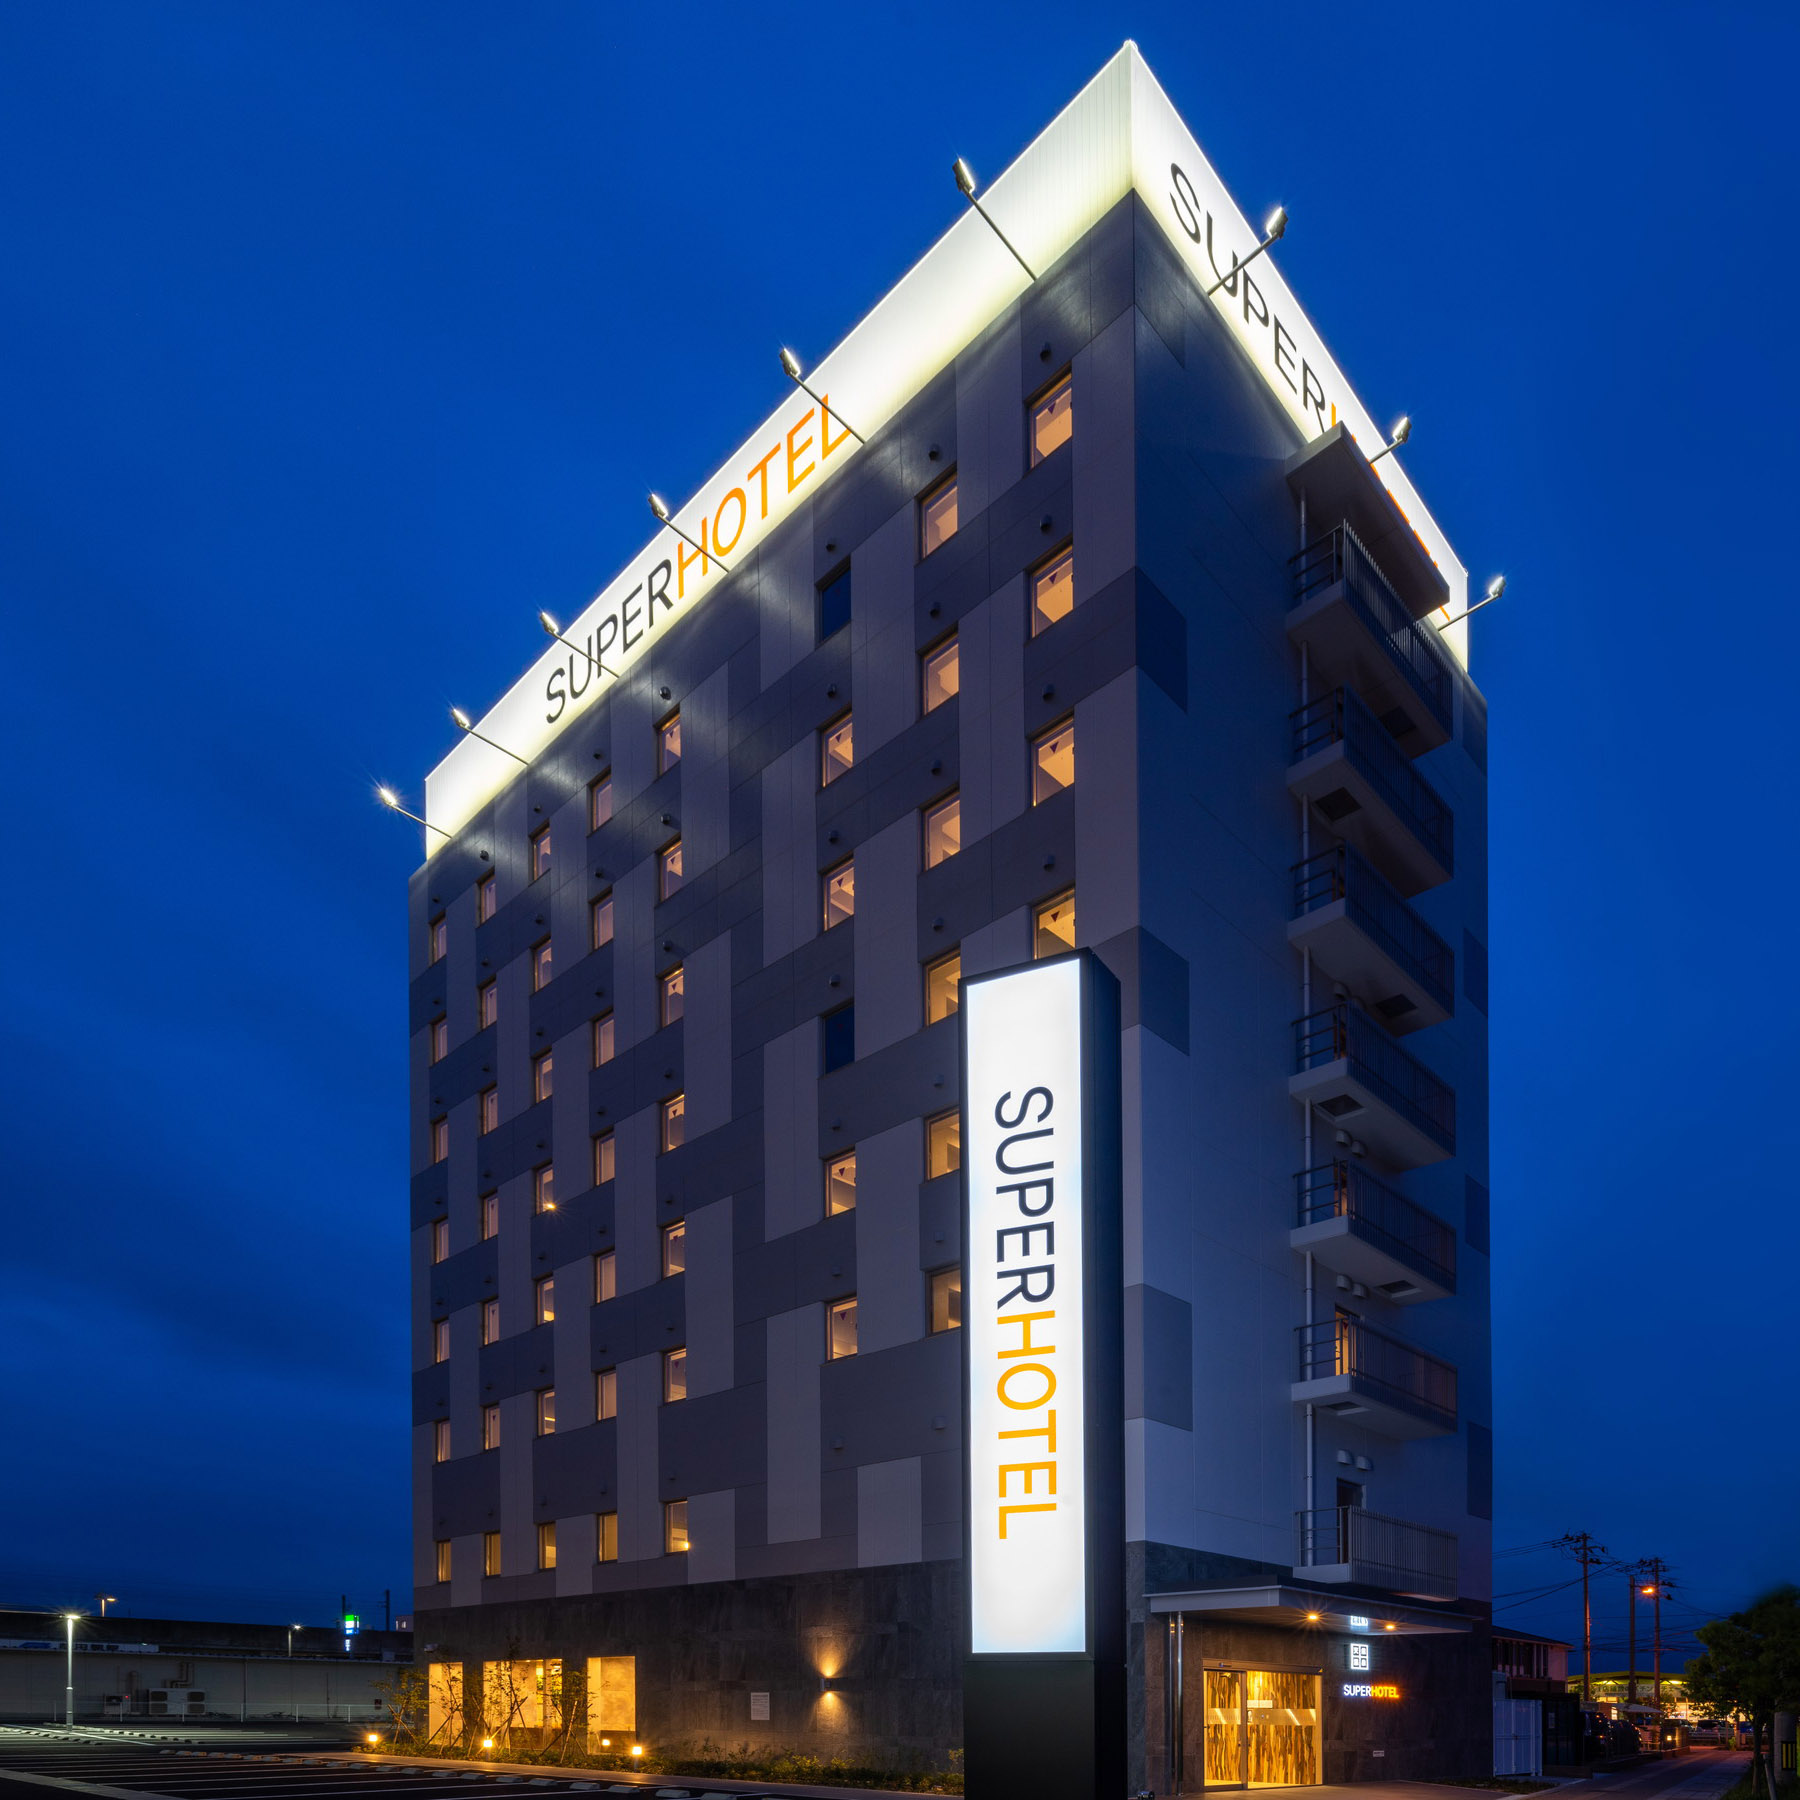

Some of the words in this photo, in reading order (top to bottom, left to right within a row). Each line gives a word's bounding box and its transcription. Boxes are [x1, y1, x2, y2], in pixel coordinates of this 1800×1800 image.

[546, 393, 852, 724] SUPERHOTEL
[994, 1086, 1057, 1539] SUPERHOTEL
[1344, 1685, 1399, 1698] SUPERHOTEL
